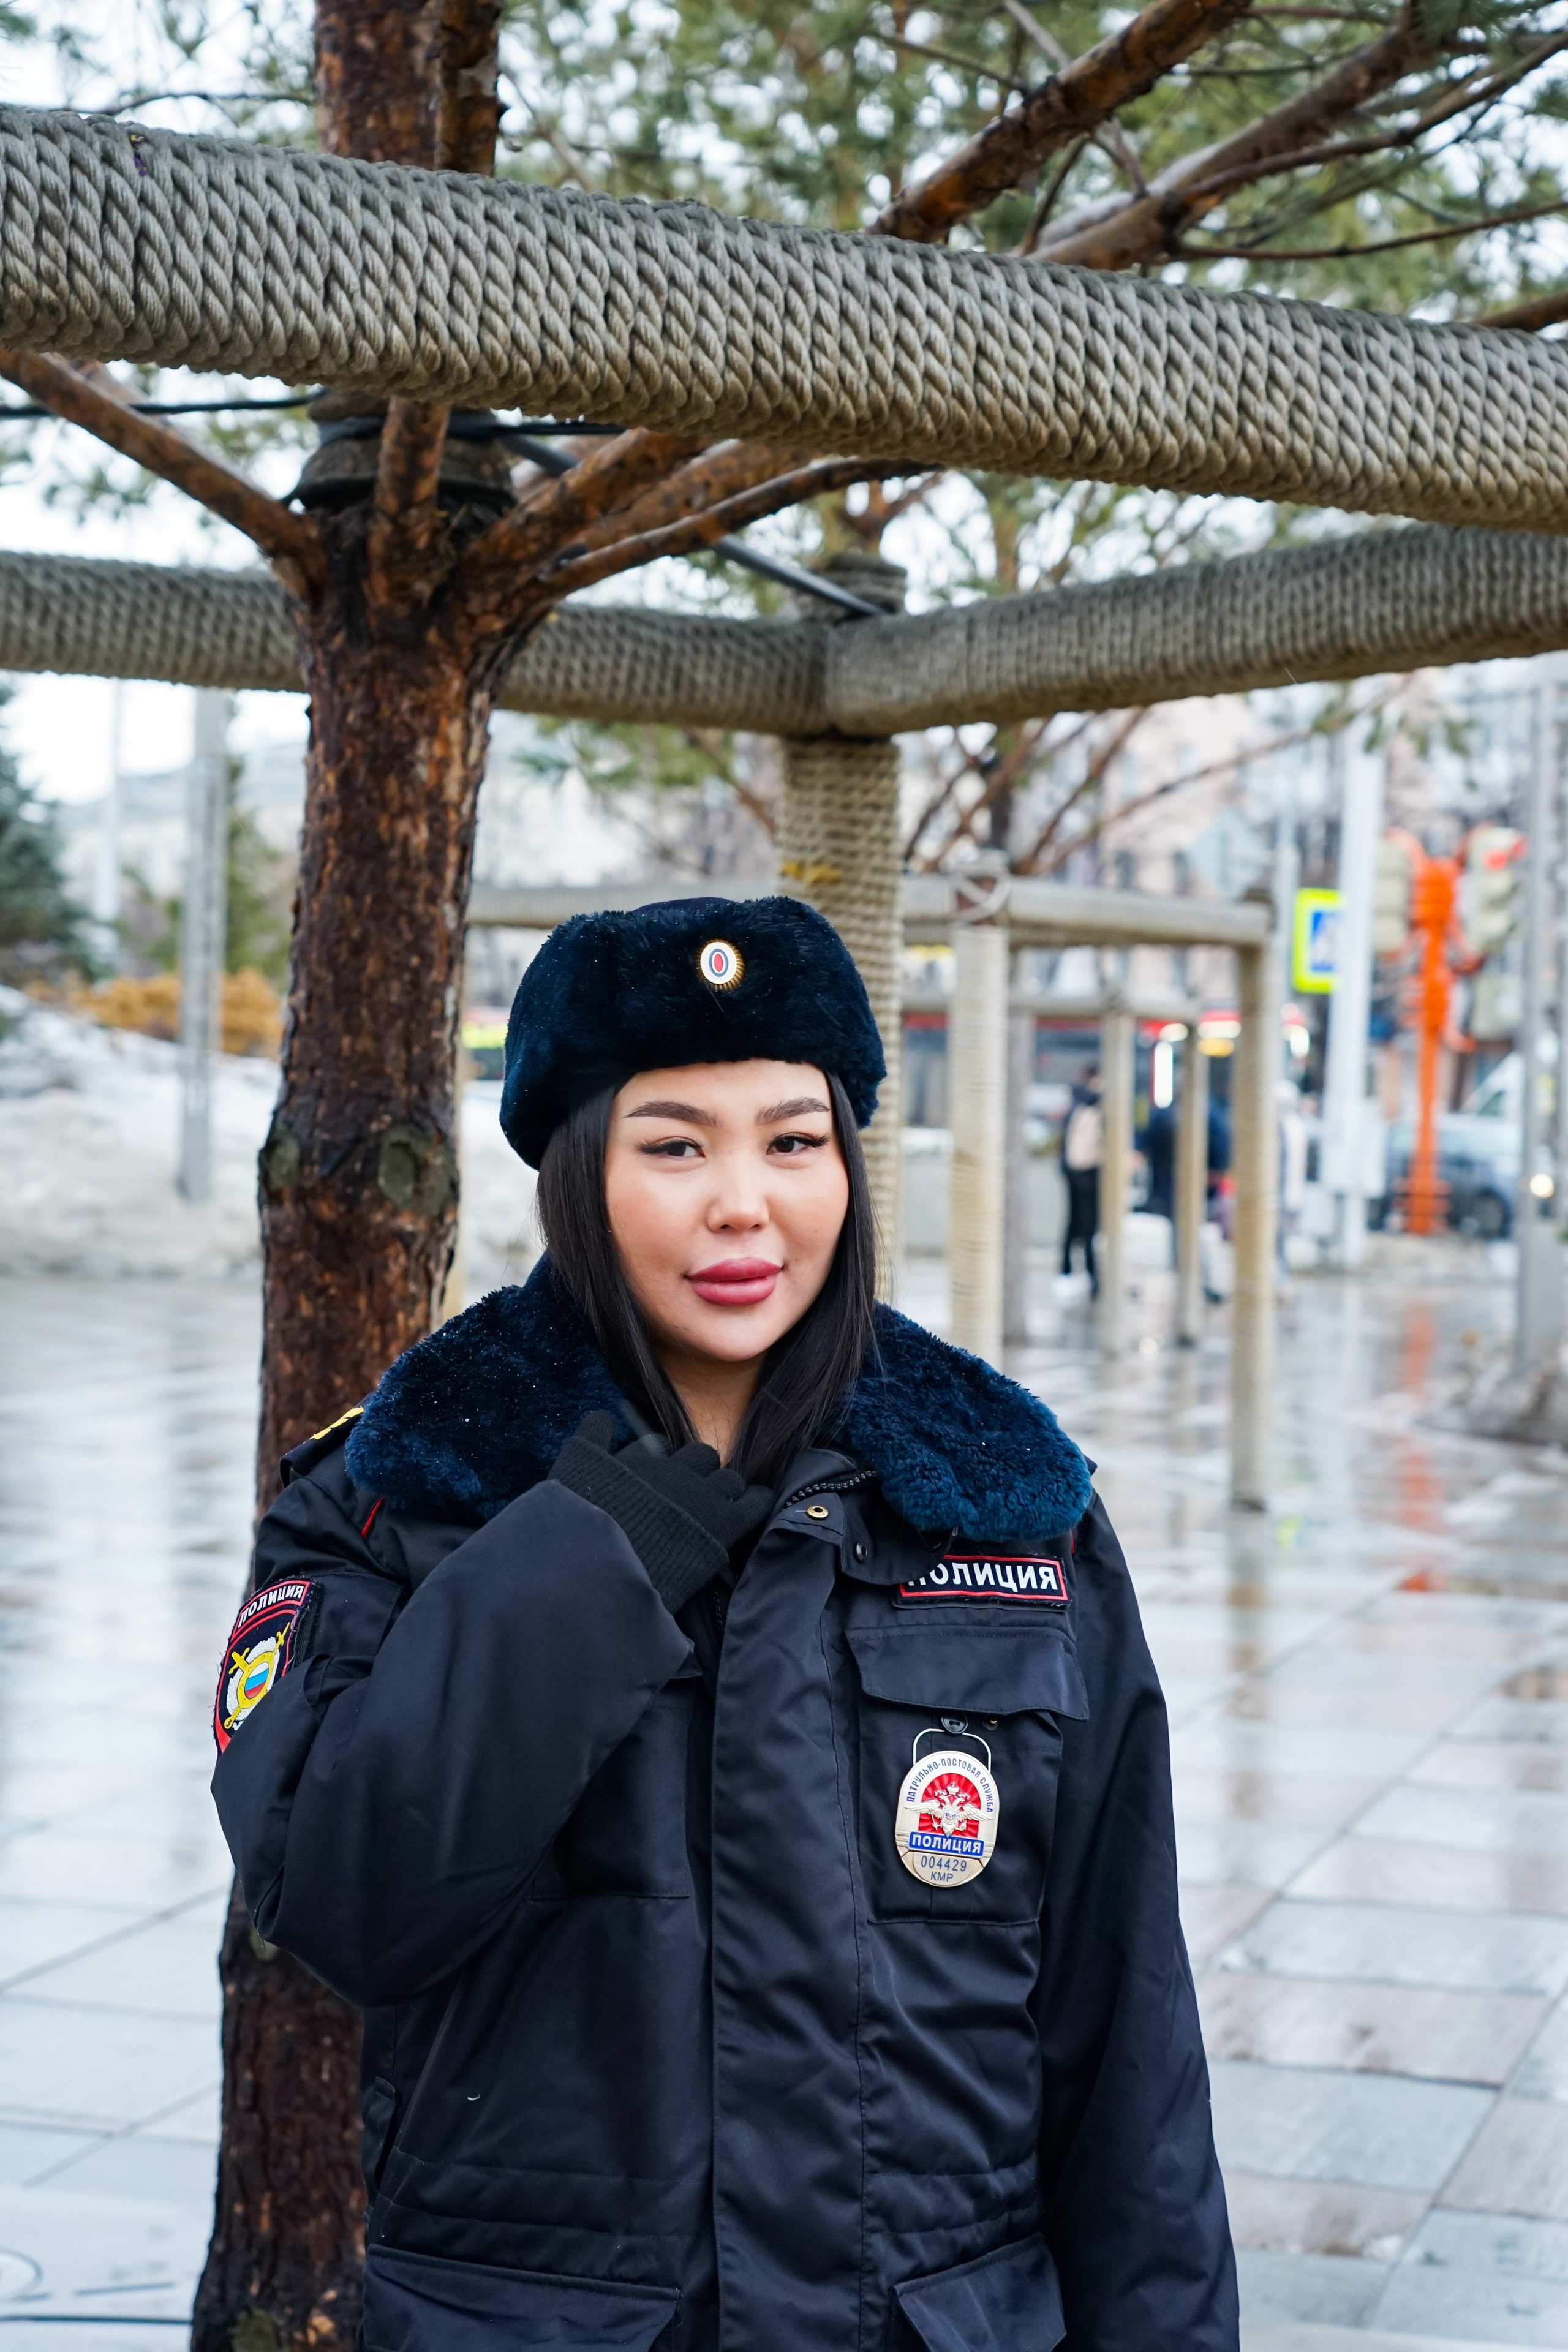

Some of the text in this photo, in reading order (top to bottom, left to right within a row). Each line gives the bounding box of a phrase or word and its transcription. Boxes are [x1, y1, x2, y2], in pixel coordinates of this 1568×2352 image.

[238, 1585, 304, 1629] ПОЛИЦИЯ
[907, 1758, 993, 1813] ПАТРУЛЬНО-ПОСТОВАЯ СЛУЖБА
[912, 1834, 982, 1854] ПОЛИЦИЯ
[921, 1855, 967, 1872] 004429
[931, 1871, 954, 1882] КМР
